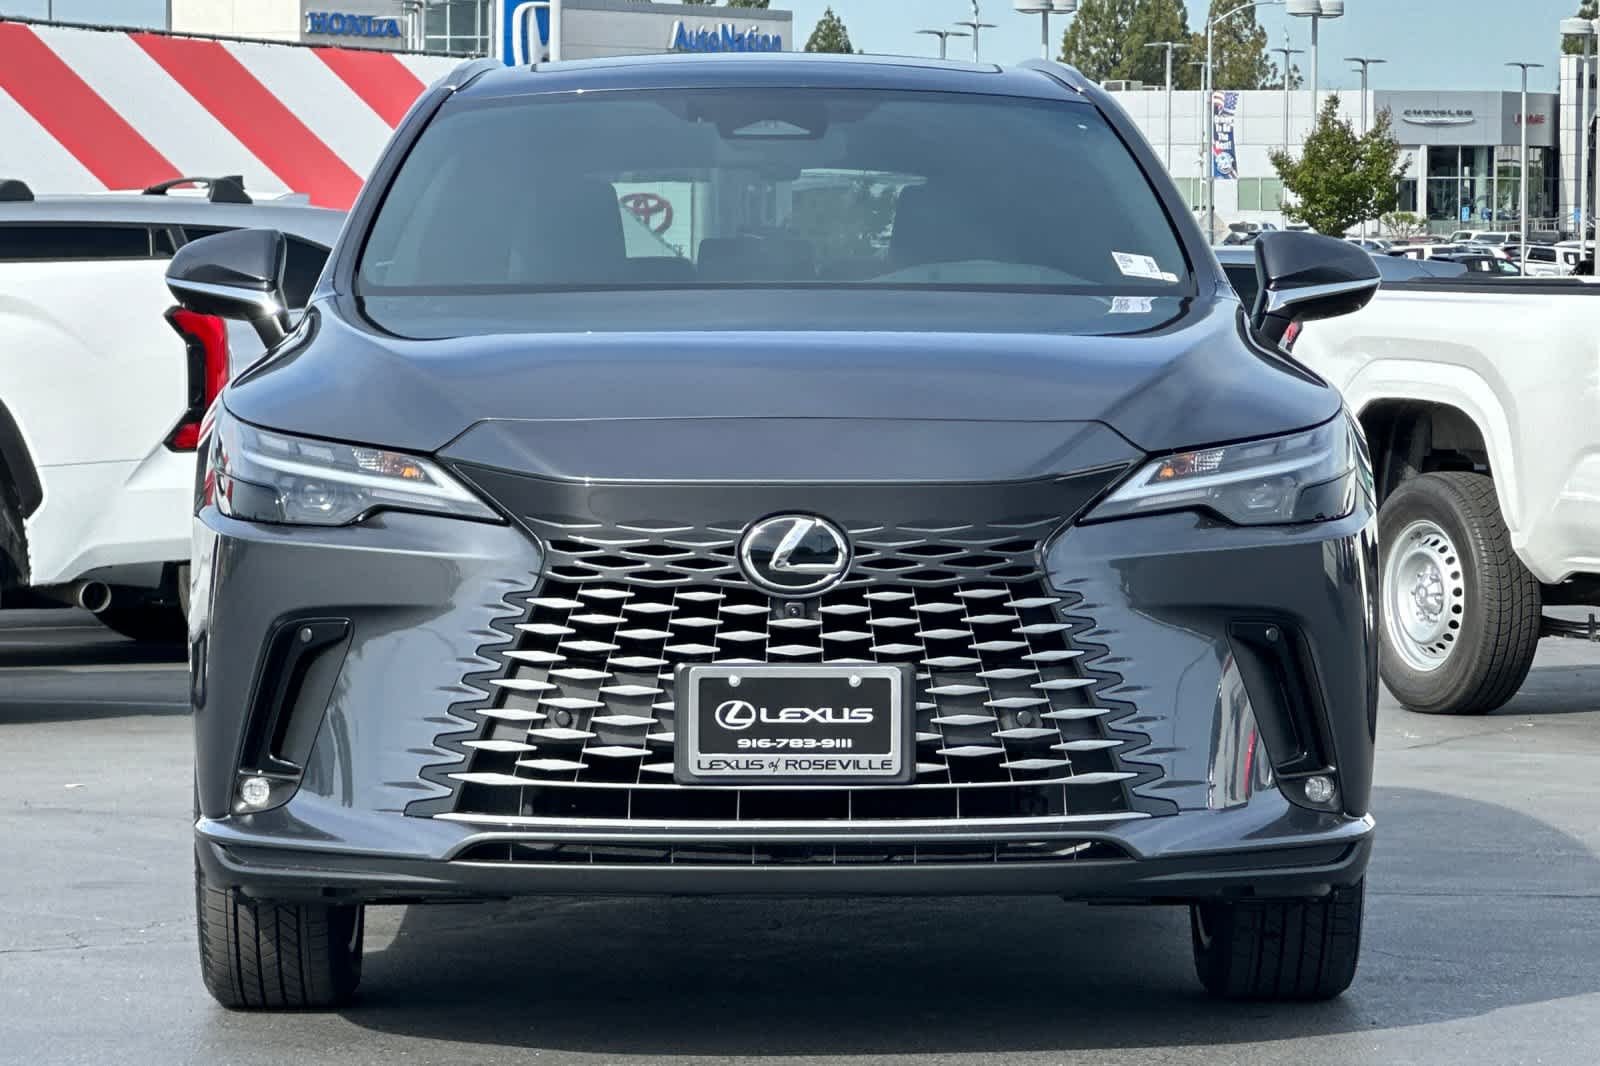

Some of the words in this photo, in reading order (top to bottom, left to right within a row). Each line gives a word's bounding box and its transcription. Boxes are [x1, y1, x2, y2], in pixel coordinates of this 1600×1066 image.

[668, 20, 782, 52] AutoNation
[760, 708, 874, 723] LEXUS
[737, 738, 852, 748] 916-783-9111
[697, 759, 764, 771] LEXUS
[768, 758, 781, 773] of
[785, 759, 893, 771] ROSEVILLE
